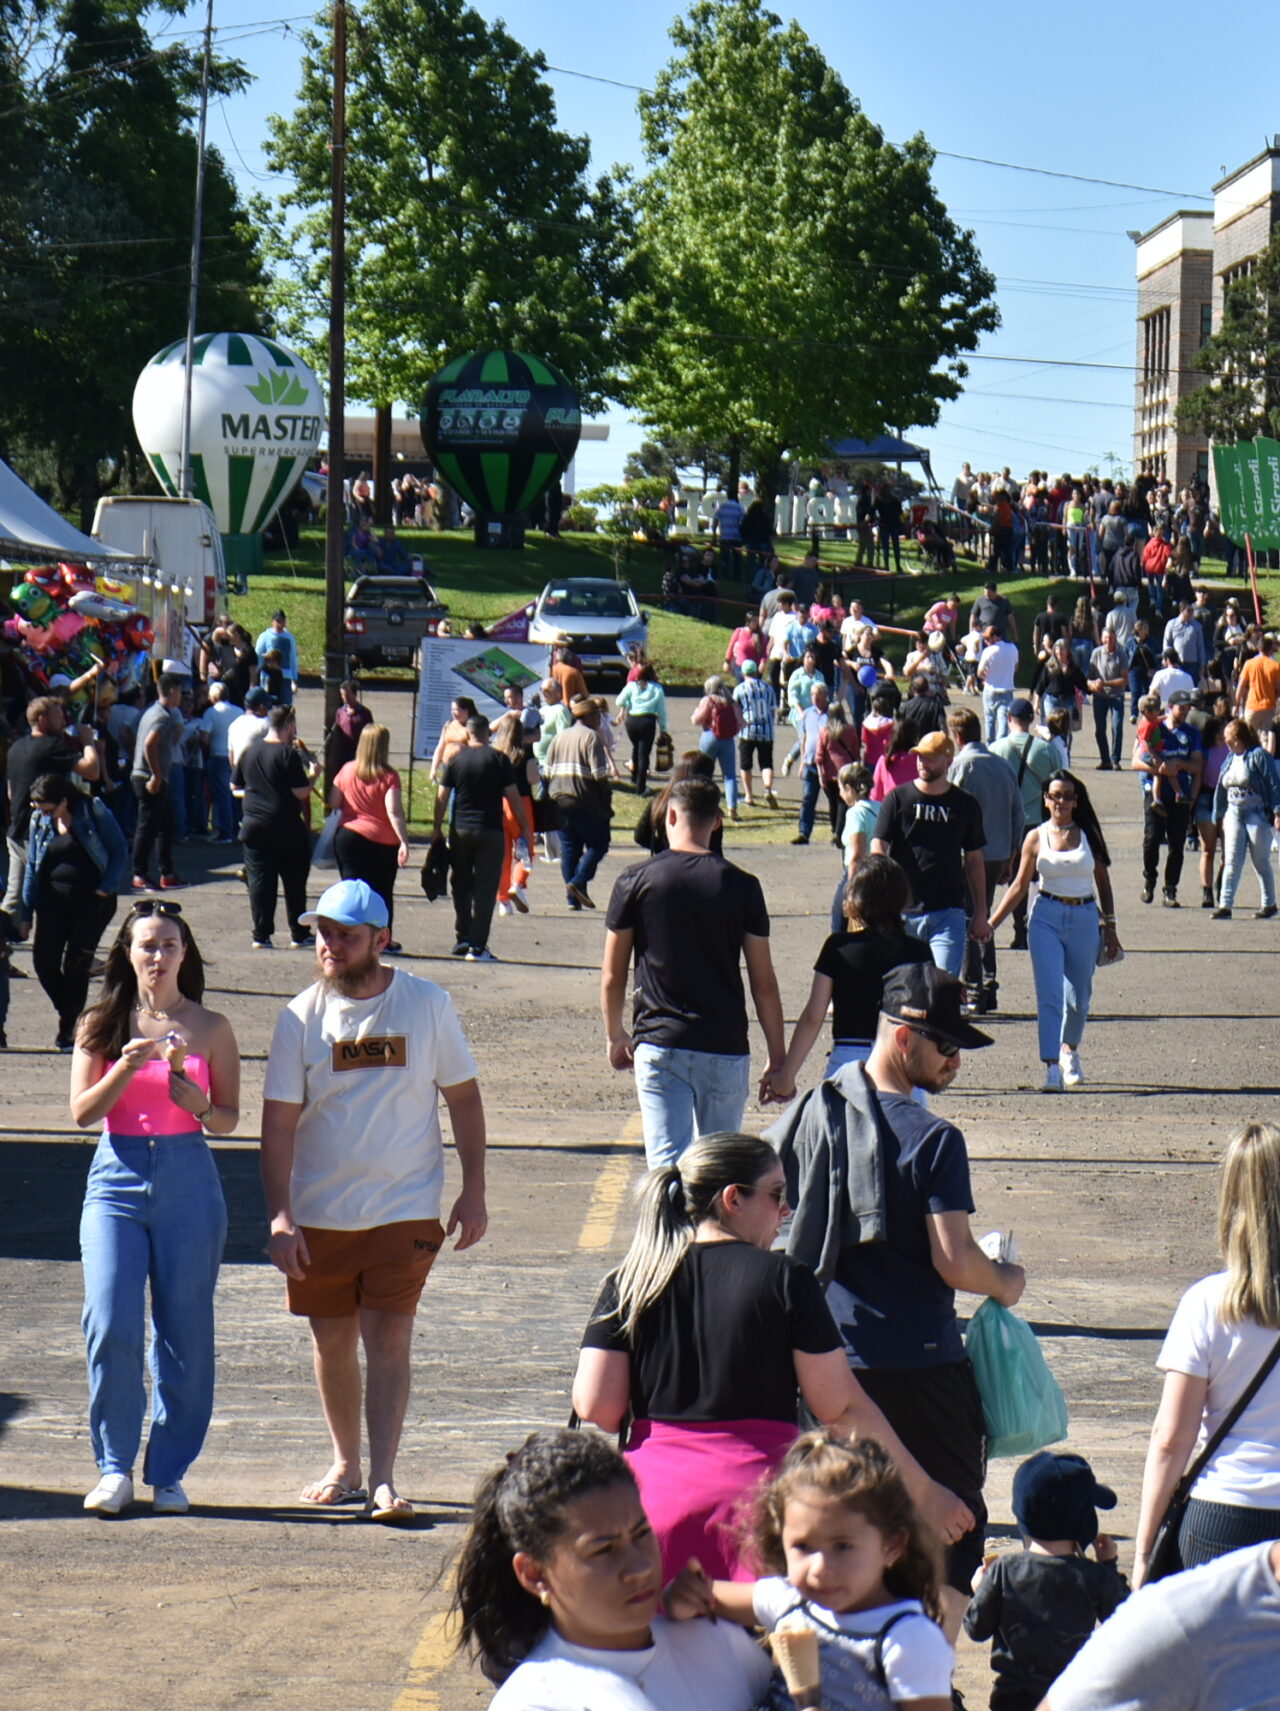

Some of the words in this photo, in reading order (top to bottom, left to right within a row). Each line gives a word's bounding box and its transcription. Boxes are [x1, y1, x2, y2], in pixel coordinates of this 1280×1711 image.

[221, 413, 321, 441] MASTER
[913, 803, 951, 823] TRN
[342, 1041, 396, 1060] NASA
